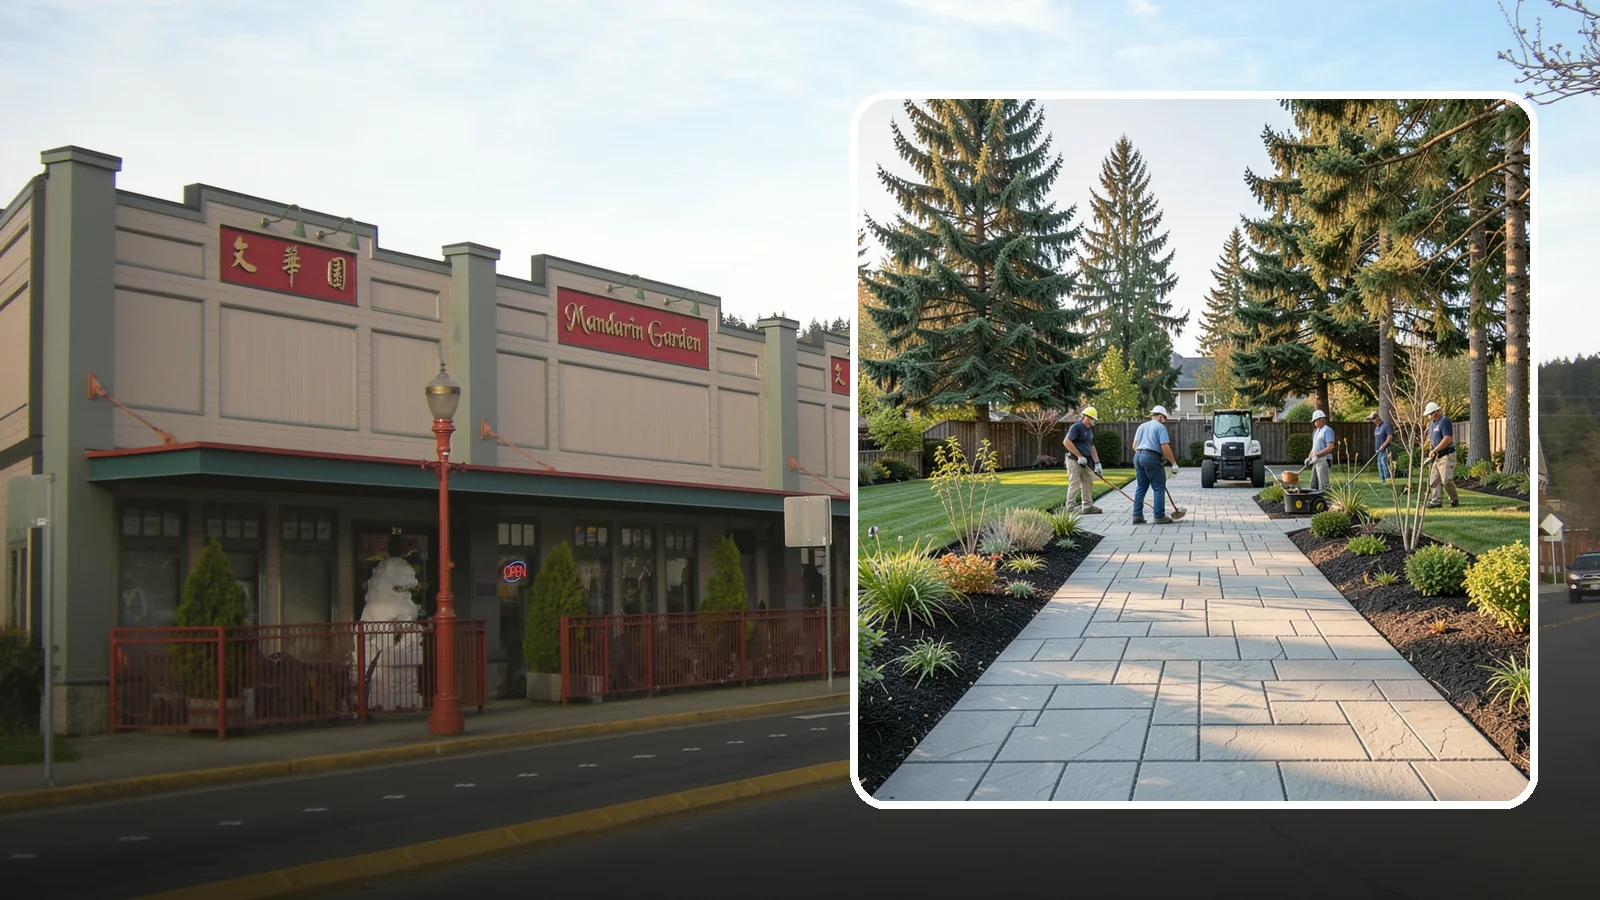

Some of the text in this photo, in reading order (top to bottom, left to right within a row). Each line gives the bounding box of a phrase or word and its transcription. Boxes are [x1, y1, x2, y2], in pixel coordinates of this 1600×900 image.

[230, 235, 346, 291] 文華園
[565, 302, 702, 353] Mandarin Garden
[503, 565, 527, 578] OPEN
